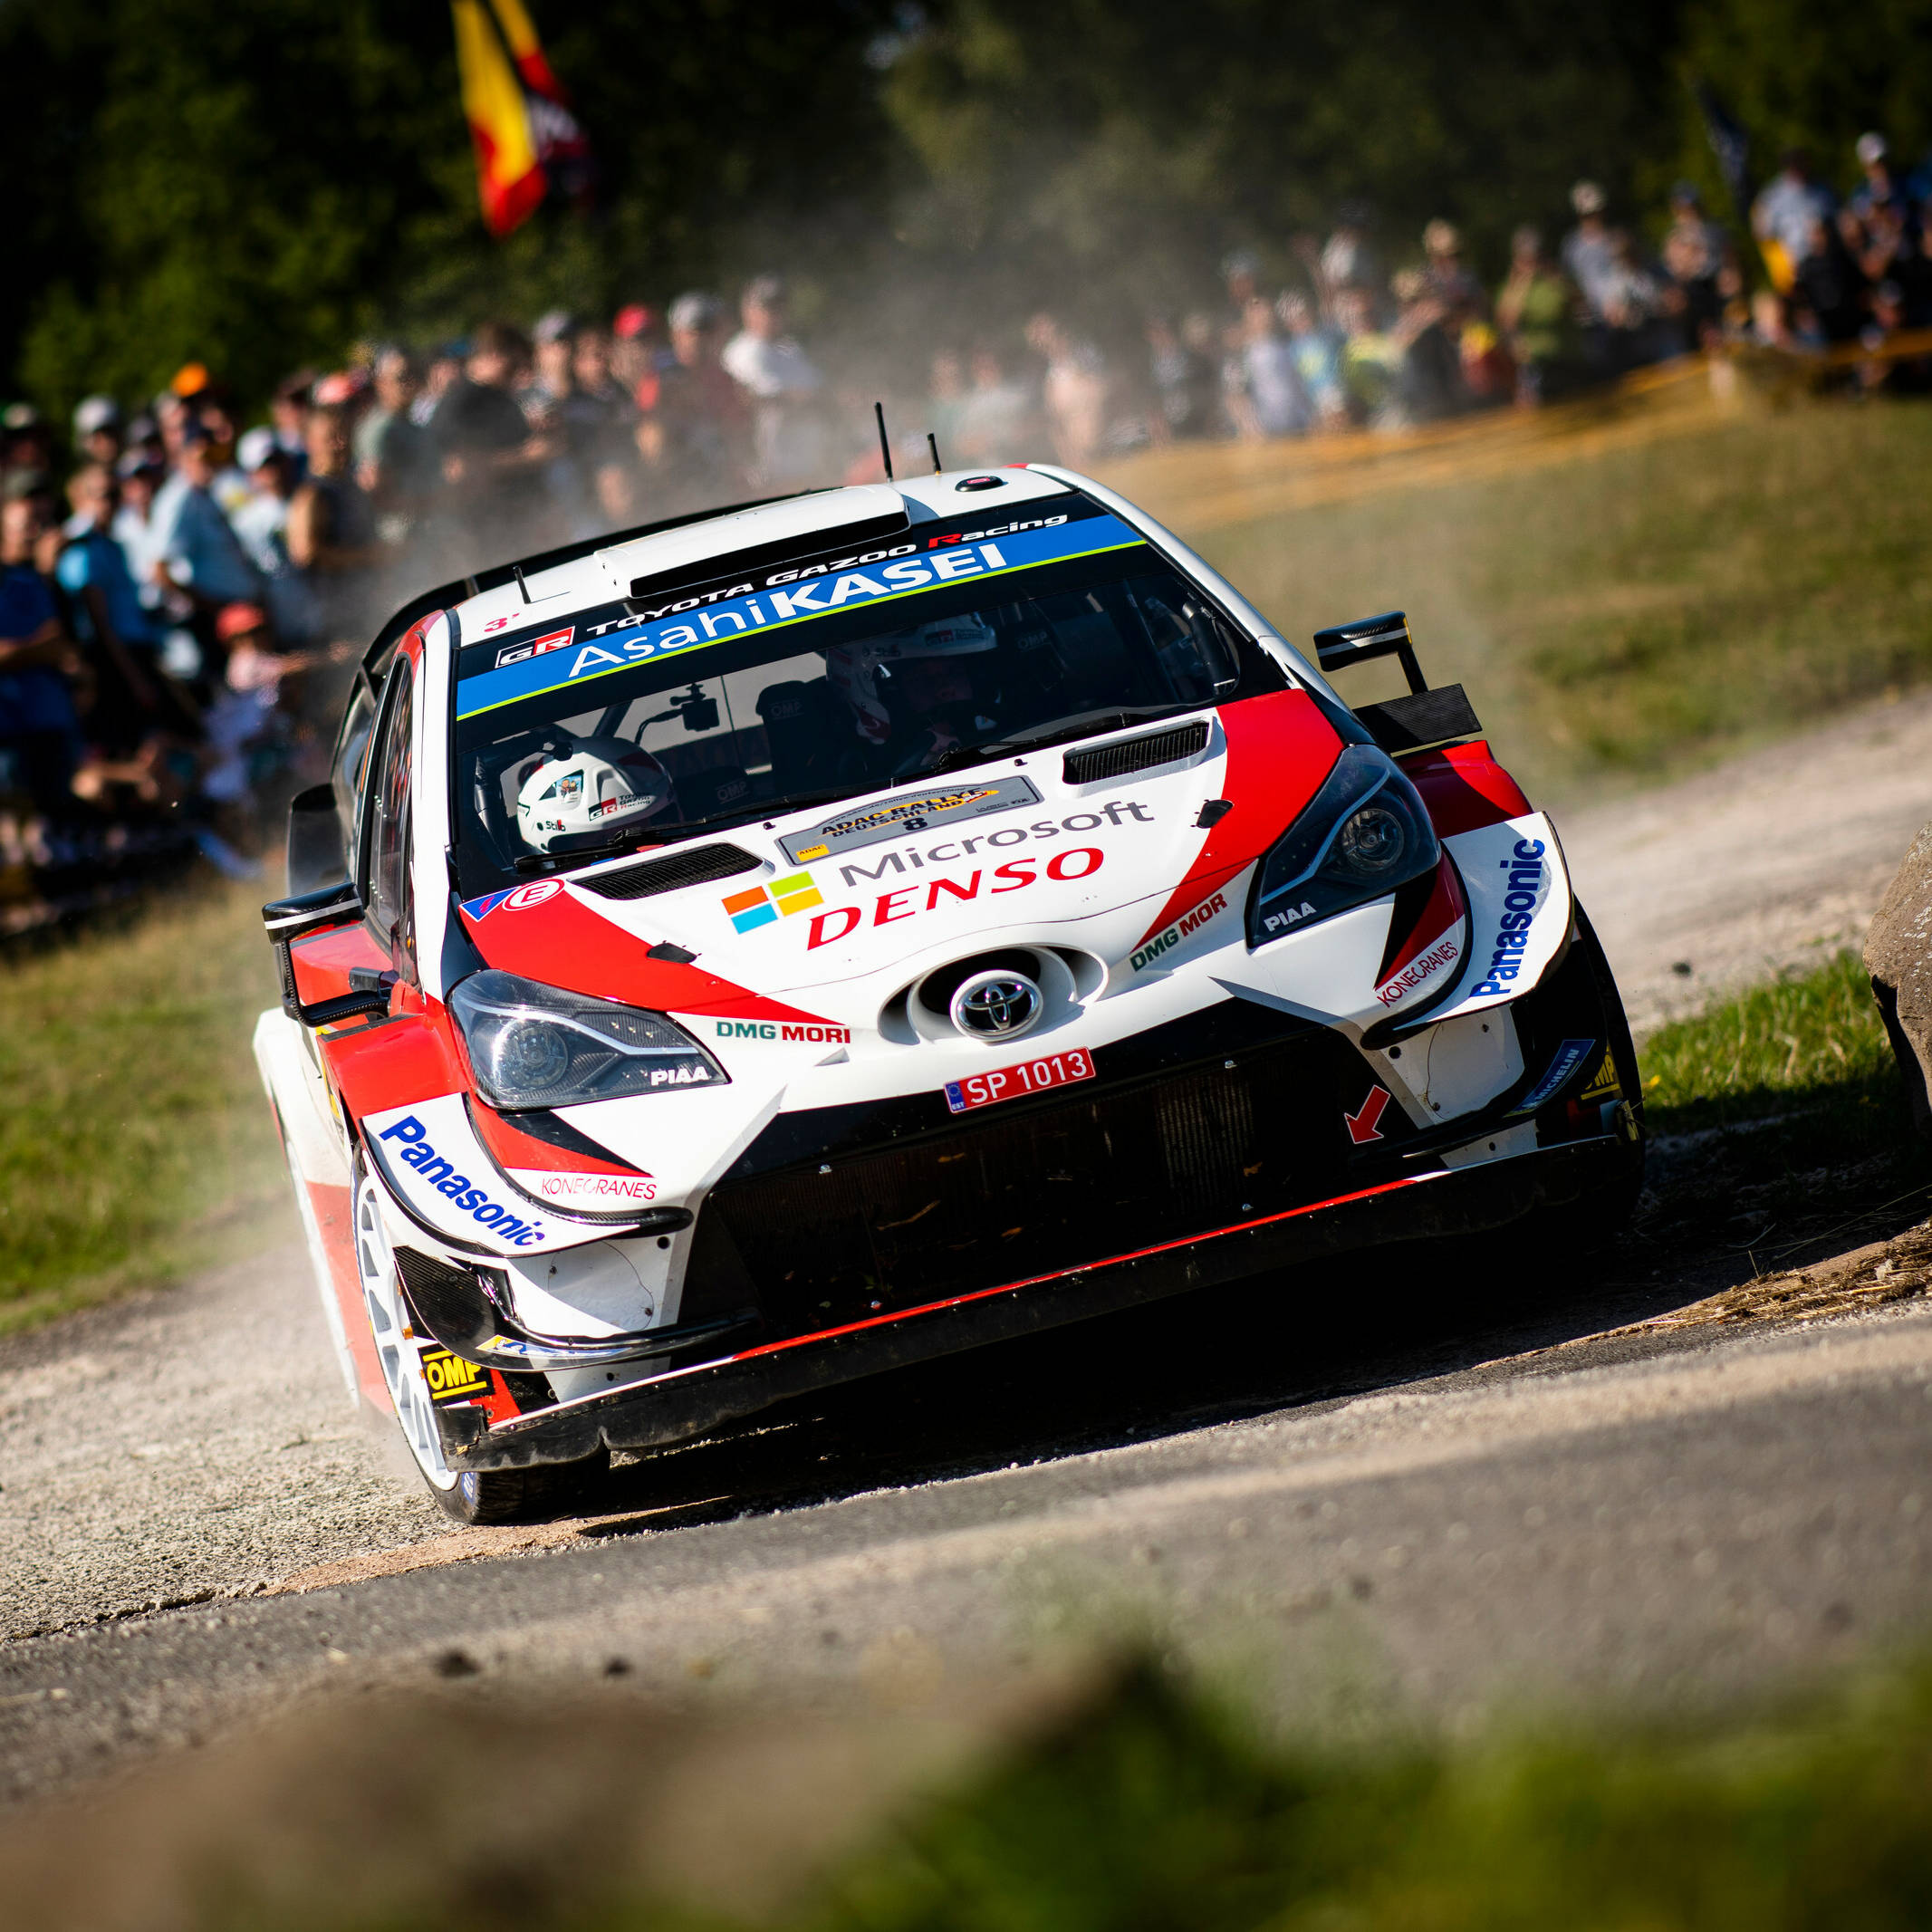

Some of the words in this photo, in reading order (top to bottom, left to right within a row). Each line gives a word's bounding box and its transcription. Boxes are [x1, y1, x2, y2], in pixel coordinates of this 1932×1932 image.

[587, 582, 755, 635] TOYOTA
[766, 543, 917, 587] GAZOO
[928, 514, 1068, 548] Racing
[569, 543, 1007, 678] AsahiKASEI
[497, 631, 572, 667] GR
[771, 701, 803, 716] OMP
[716, 781, 747, 802] OMP
[589, 800, 617, 821] GR
[822, 812, 885, 834] ADAC
[890, 787, 984, 815] RALLYE
[831, 800, 964, 837] DEUTSCHLAND
[902, 817, 928, 831] 8
[799, 845, 823, 856] ADAC
[839, 801, 1155, 887] Microsoft
[521, 885, 549, 903] E
[806, 848, 1104, 951] DENSO
[1264, 902, 1316, 932] PIAA
[1470, 839, 1545, 997] Panasonic
[1129, 928, 1179, 972] DMG
[1377, 941, 1458, 1007] KONECRANES
[716, 1022, 776, 1040] DMG
[782, 1026, 851, 1044] MORI
[650, 1066, 709, 1086] PIAA
[966, 1073, 1006, 1103] SP
[1017, 1053, 1087, 1090] 1013
[1535, 1048, 1580, 1101] MICHELIN
[1584, 1054, 1615, 1091] MP
[951, 1102, 965, 1110] EST
[379, 1115, 545, 1246] Panasonic
[542, 1177, 658, 1200] KONECRANES
[427, 1356, 482, 1390] OMP
